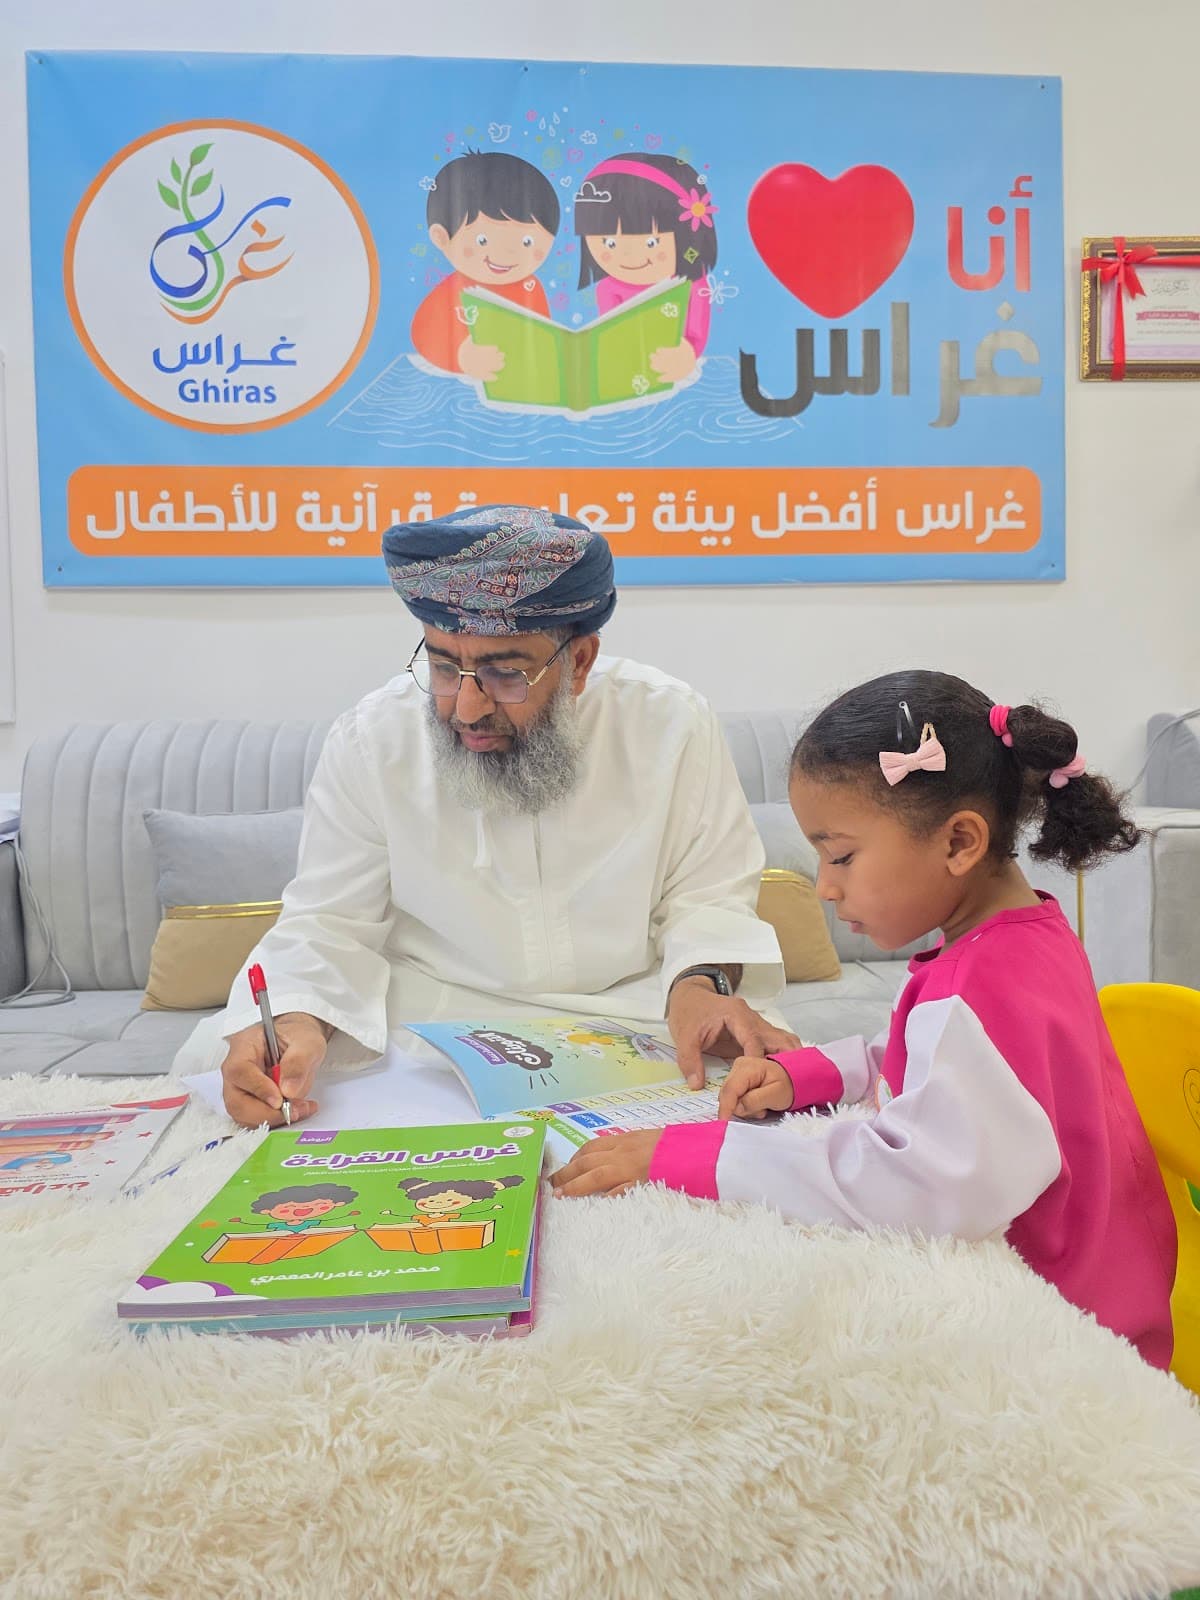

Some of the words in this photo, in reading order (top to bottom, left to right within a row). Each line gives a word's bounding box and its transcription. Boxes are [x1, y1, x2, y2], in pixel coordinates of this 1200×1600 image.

[947, 175, 1033, 292] أنا
[152, 334, 297, 374] غراس
[739, 301, 1042, 428] غراس
[178, 379, 277, 404] Ghiras
[86, 483, 278, 539] للأطفال
[652, 489, 735, 546] بيئة
[752, 477, 878, 539] أفضل
[896, 490, 1026, 544] غراس
[282, 1149, 409, 1170] القراءة
[413, 1143, 519, 1165] غراس
[250, 1271, 324, 1286] المعمري
[323, 1269, 364, 1281] عامر
[367, 1269, 391, 1279] بن
[394, 1265, 441, 1275] محمد
